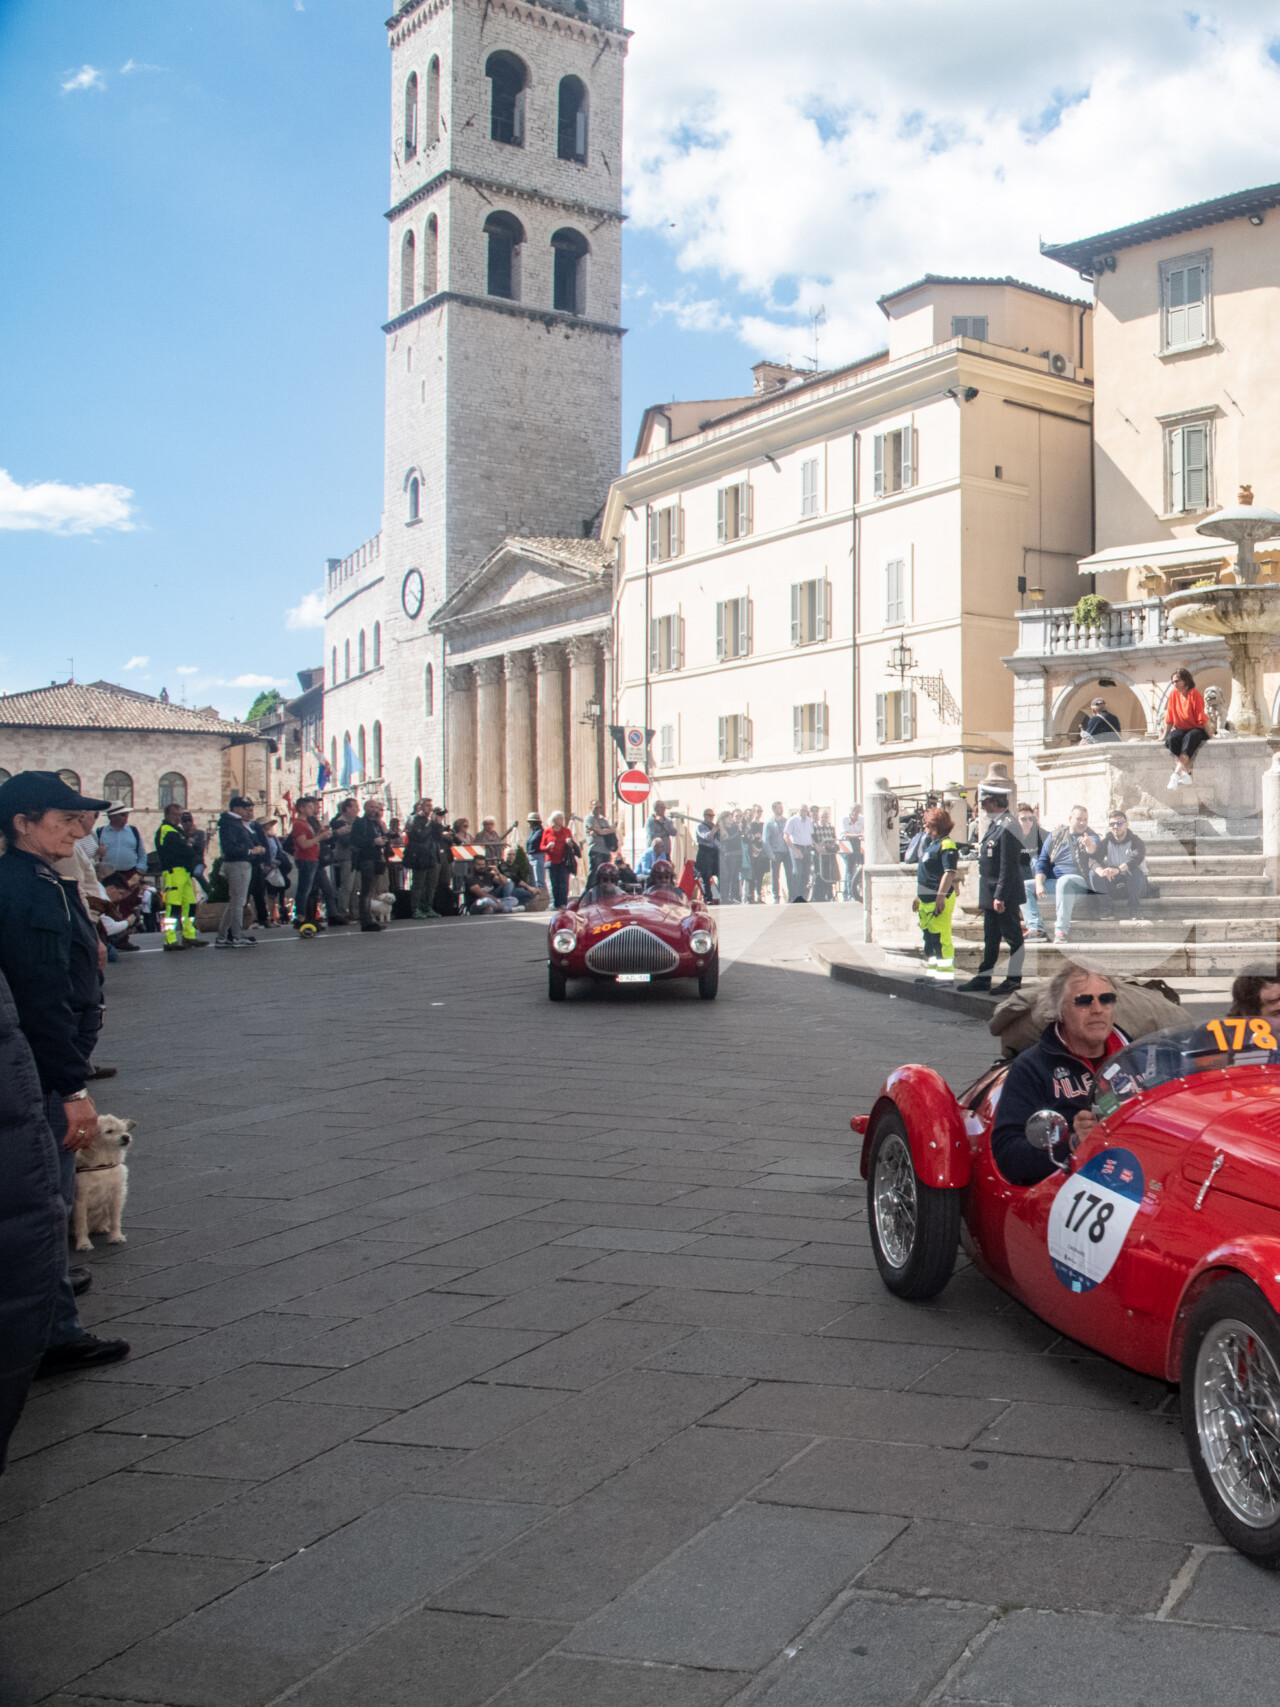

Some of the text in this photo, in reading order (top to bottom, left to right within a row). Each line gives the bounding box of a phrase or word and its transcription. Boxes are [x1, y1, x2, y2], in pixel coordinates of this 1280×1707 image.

[592, 921, 622, 935] 204
[1206, 1018, 1278, 1051] 178
[1064, 1190, 1114, 1244] 178
